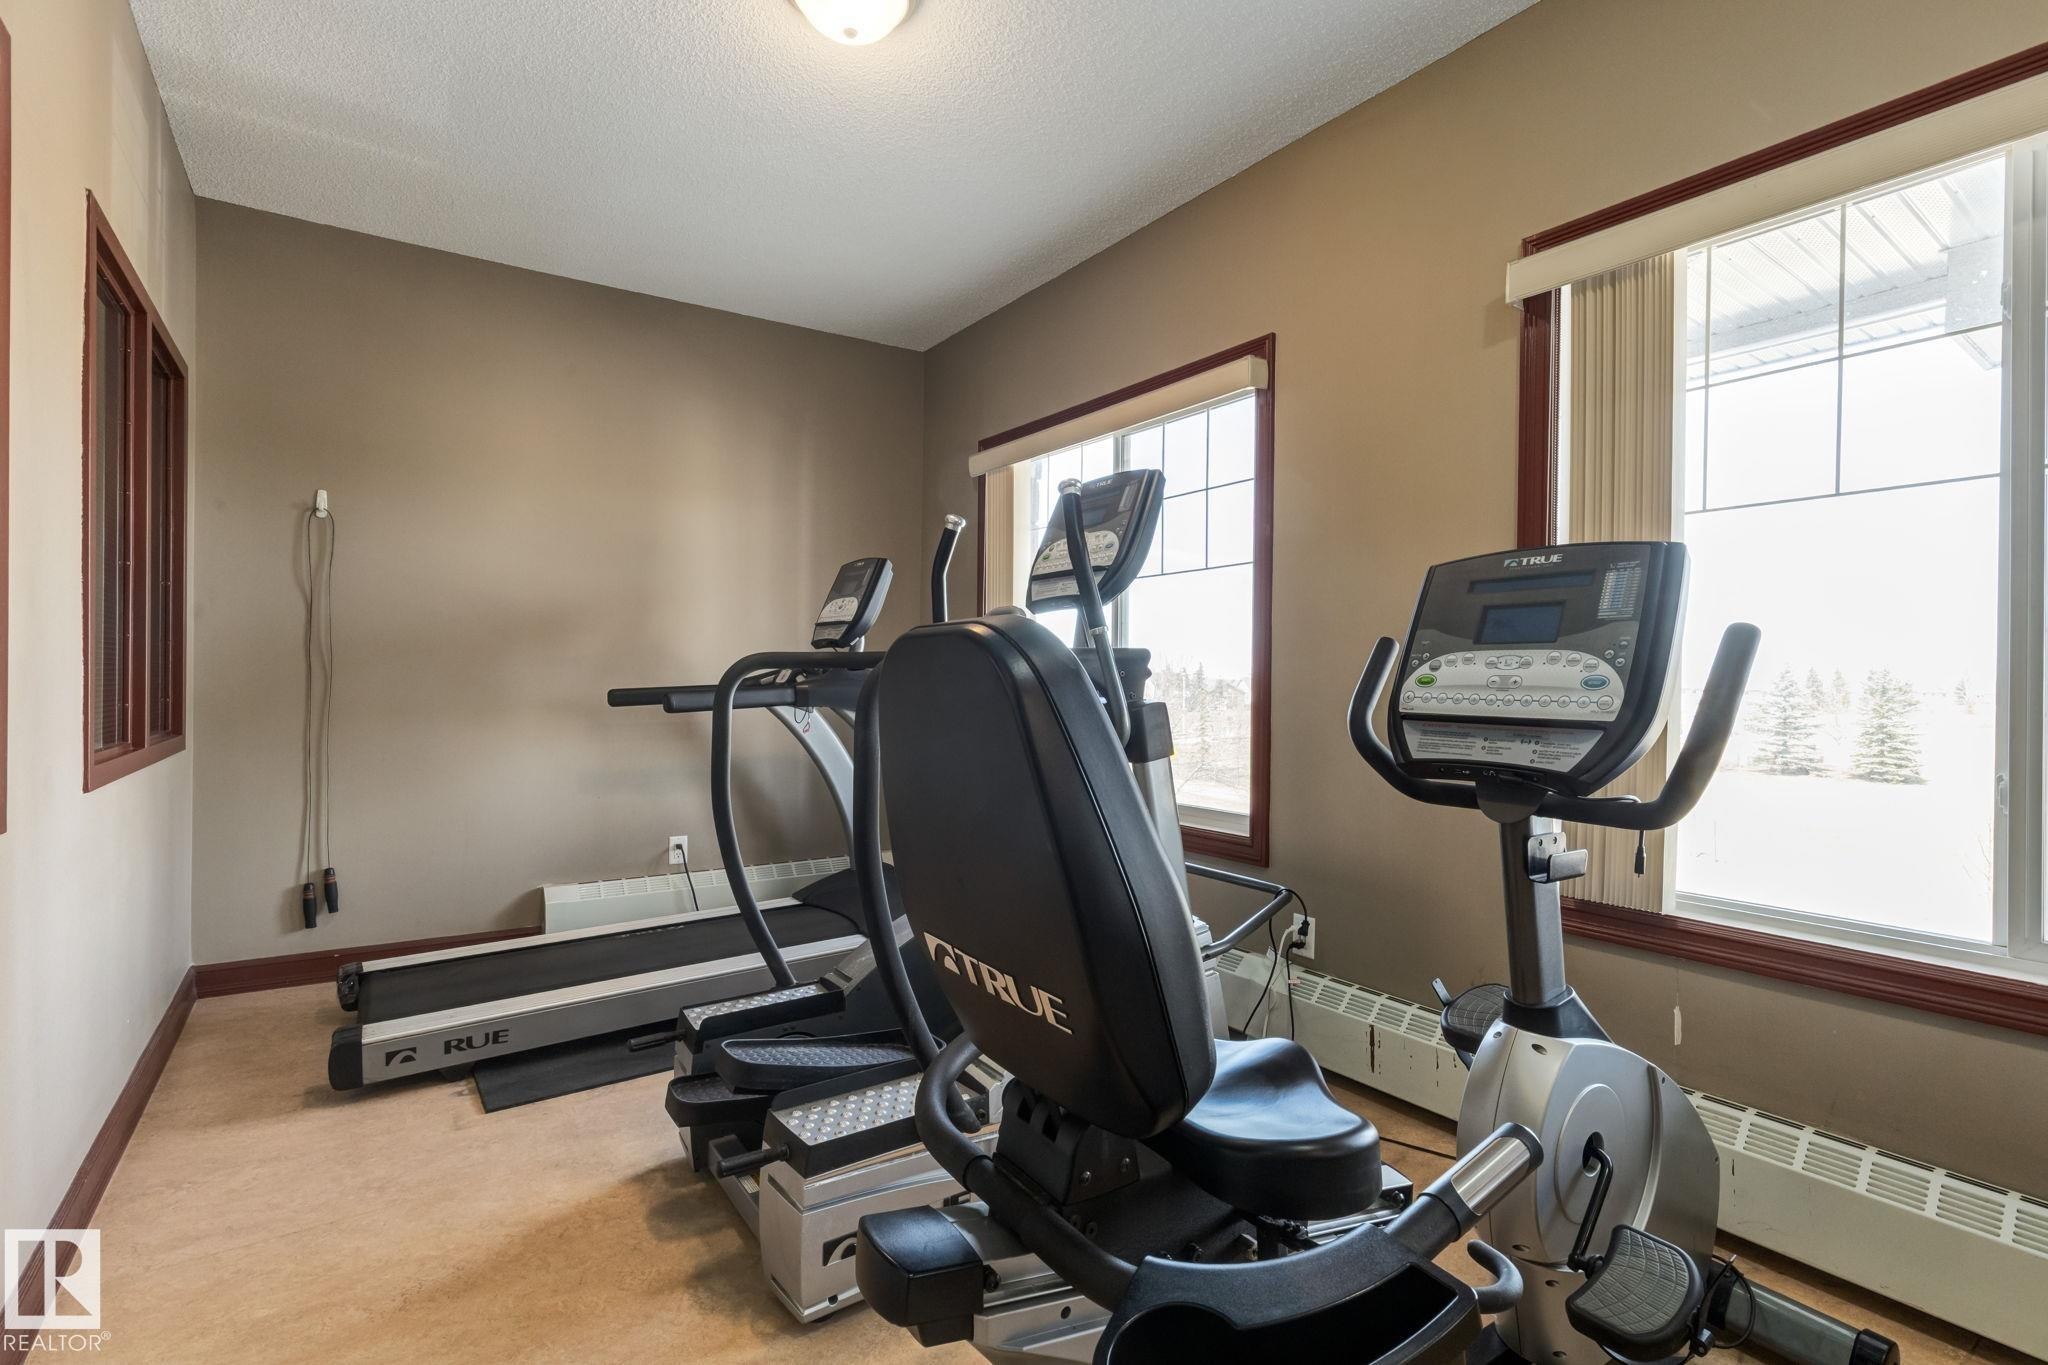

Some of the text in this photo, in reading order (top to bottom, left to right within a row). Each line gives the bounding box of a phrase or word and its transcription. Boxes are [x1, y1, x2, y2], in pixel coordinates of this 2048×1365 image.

[1520, 553, 1563, 566] TRUE
[954, 947, 1072, 1035] TRUE
[444, 1029, 510, 1055] RUE
